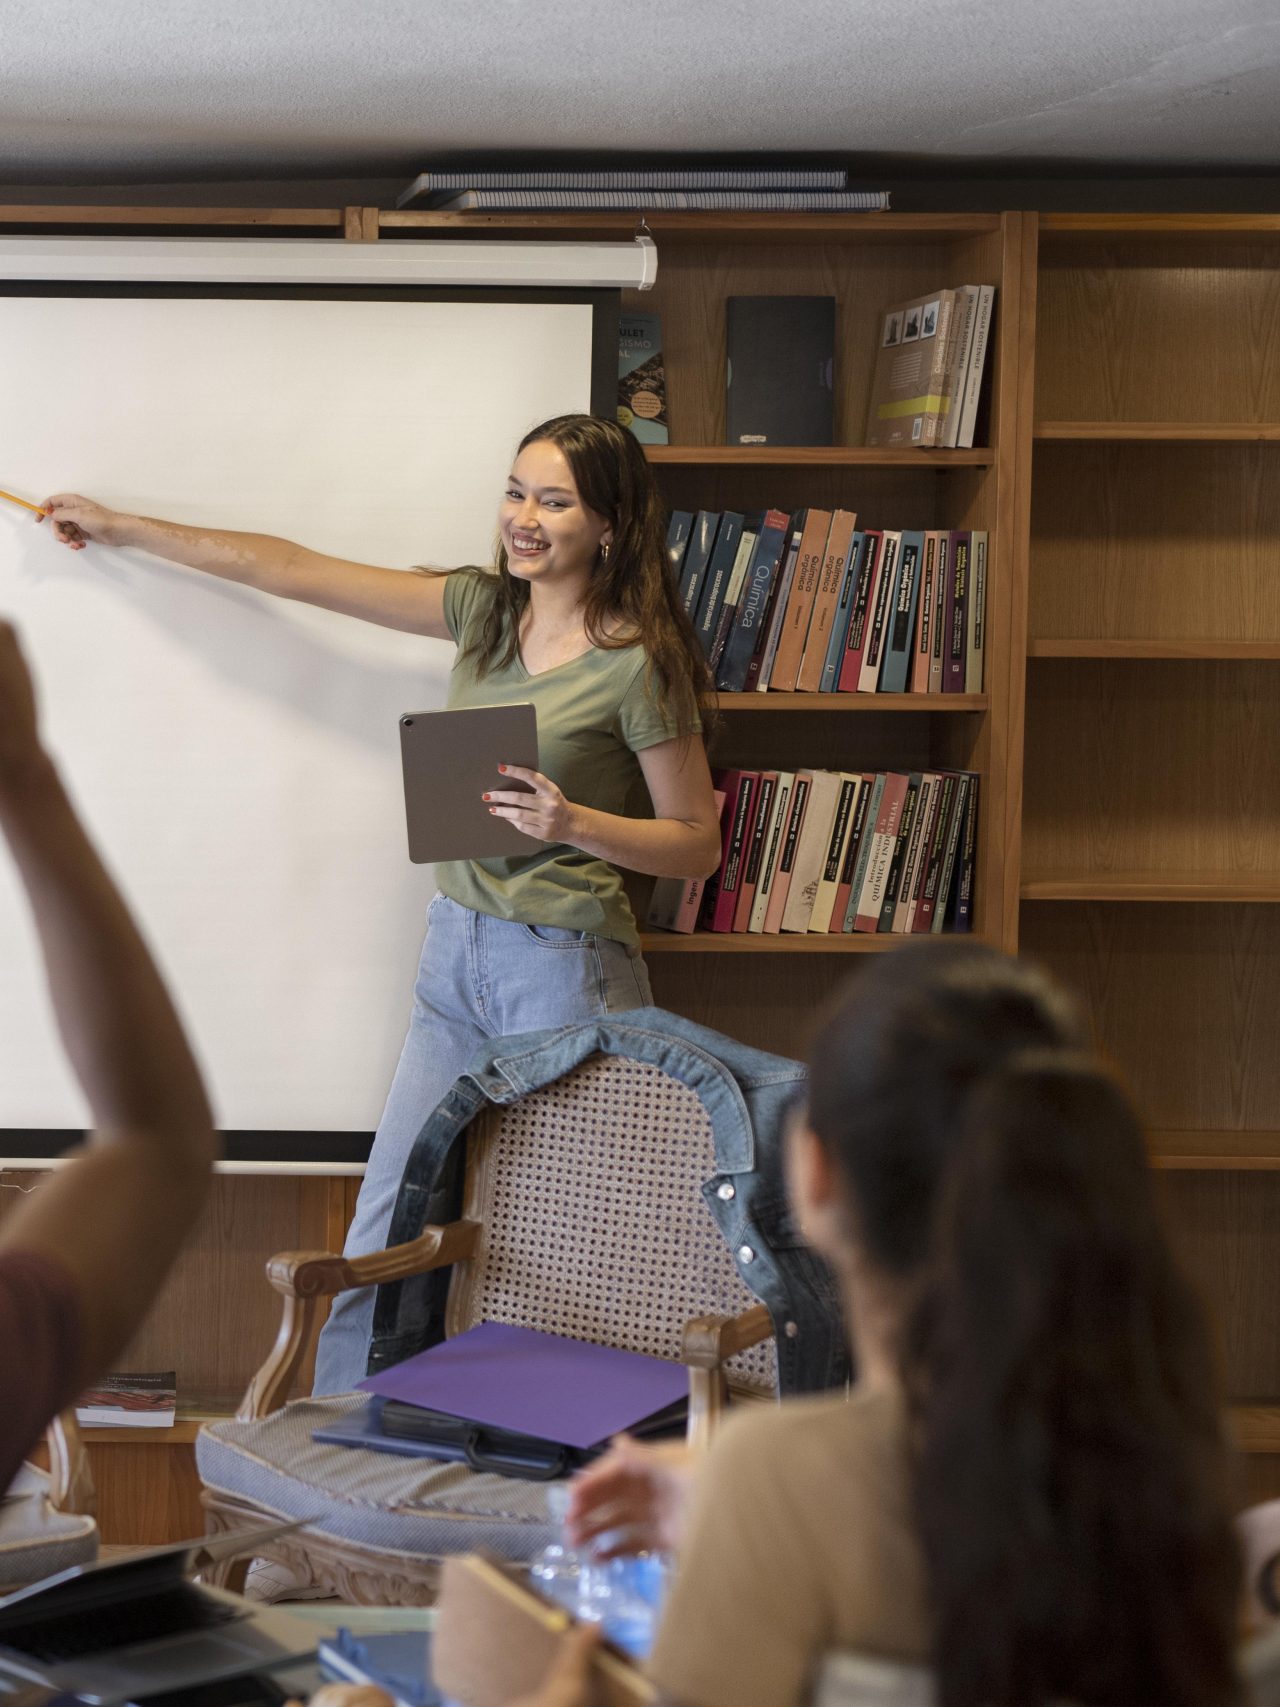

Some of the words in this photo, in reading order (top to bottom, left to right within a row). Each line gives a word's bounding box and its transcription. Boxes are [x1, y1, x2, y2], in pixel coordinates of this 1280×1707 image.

[964, 305, 972, 329] HOGAR
[968, 294, 974, 304] UN
[980, 305, 988, 329] HOGAR
[983, 294, 990, 304] UN
[958, 330, 969, 369] SOSTENIBLE
[974, 331, 985, 369] SOSTENIBLE
[797, 554, 810, 591] orgánica
[805, 555, 820, 593] Química
[822, 555, 835, 593] orgánica
[830, 557, 844, 594] Química
[742, 565, 770, 627] Química
[868, 835, 883, 883] Introducción
[871, 860, 886, 902] QUÍMICA
[881, 801, 899, 856] INDUSTRIAL
